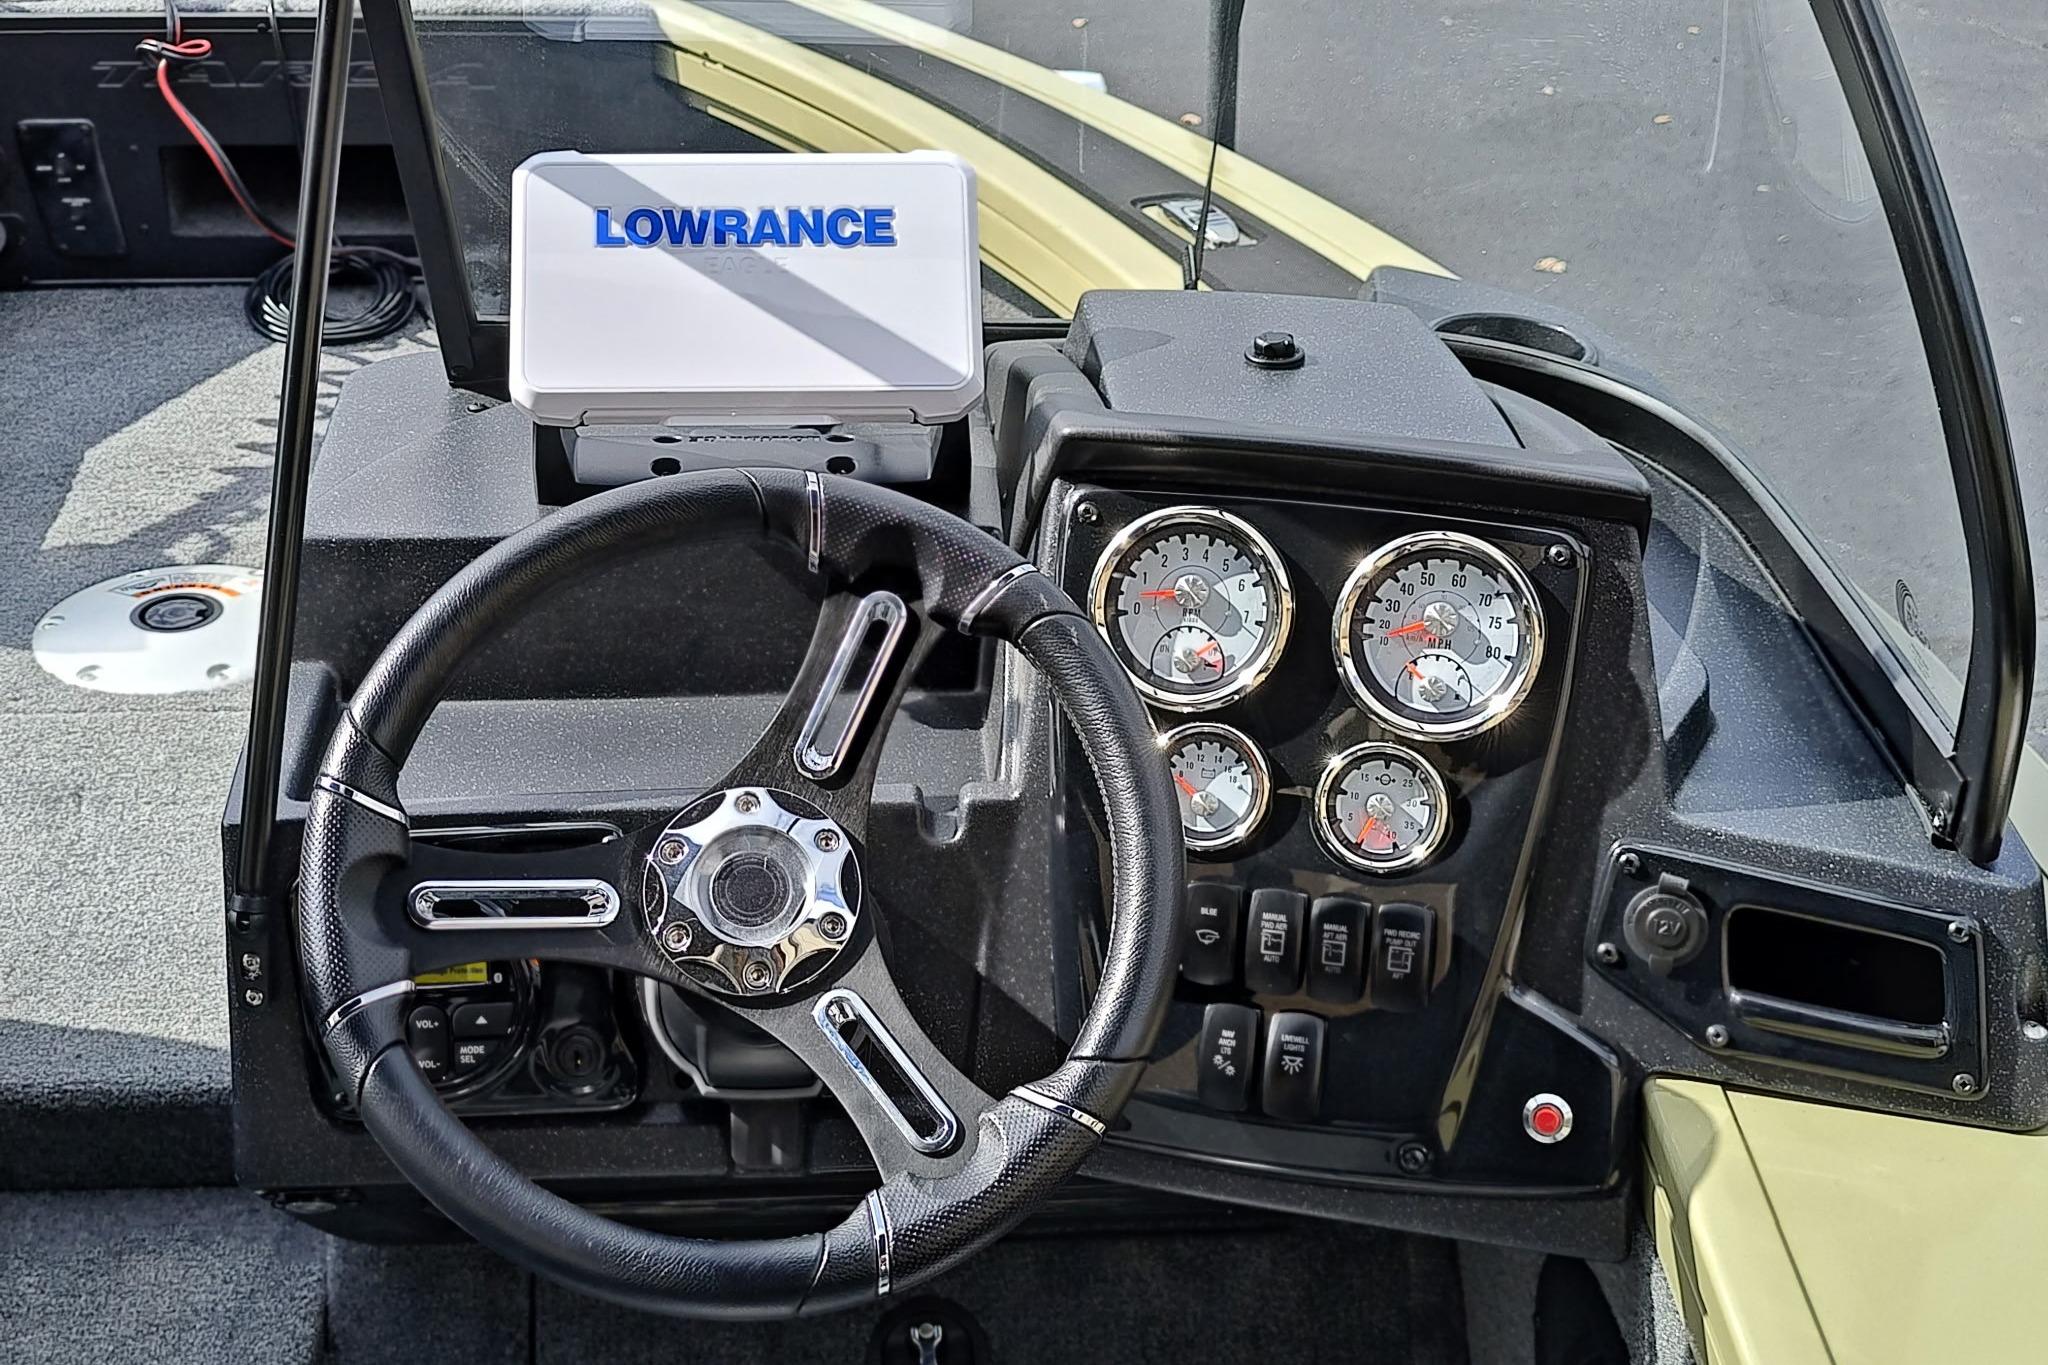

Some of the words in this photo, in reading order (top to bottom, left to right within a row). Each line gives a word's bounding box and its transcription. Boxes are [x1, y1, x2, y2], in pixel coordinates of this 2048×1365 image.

[594, 207, 897, 247] LOWRANCE
[1182, 547, 1190, 561] 3
[1202, 549, 1210, 563] 4
[1161, 554, 1169, 568] 2
[1222, 558, 1230, 572] 5
[1142, 571, 1148, 585] 1
[1420, 572, 1435, 586] 50
[1451, 573, 1467, 588] 60
[1238, 579, 1246, 592] 6
[1400, 582, 1414, 596] 40
[1478, 593, 1493, 607] 70
[1133, 601, 1141, 615] 0
[1182, 606, 1201, 617] RPM
[1385, 599, 1400, 613] 30
[1244, 610, 1250, 623] 7
[1379, 619, 1391, 630] 20
[1488, 616, 1502, 630] 75
[1379, 636, 1389, 646] 10
[1427, 637, 1452, 650] MPH
[1485, 645, 1501, 660] 80
[1197, 753, 1205, 762] 12
[1214, 755, 1223, 764] 14
[1186, 761, 1194, 769] 10
[1229, 775, 1237, 784] 18
[1361, 773, 1370, 782] 15
[1402, 779, 1413, 788] 25
[1350, 791, 1360, 800] 10
[1406, 800, 1418, 808] 30
[1347, 812, 1354, 821] 5
[1404, 821, 1415, 830] 35
[1200, 907, 1218, 916] BILGE
[1262, 911, 1288, 922] MANUAL
[1260, 920, 1275, 929] FWD
[1275, 922, 1288, 931] AER
[1323, 923, 1348, 933] MANUAL
[1653, 918, 1681, 936] 12V
[1264, 954, 1280, 963] AUTO
[416, 1019, 439, 1029] VOL+
[1221, 1028, 1236, 1038] NAV
[1280, 1033, 1310, 1046] LIVEWELL
[460, 1045, 485, 1055] MODE
[1283, 1043, 1306, 1052] LIGHTS
[459, 1055, 476, 1064] SEL
